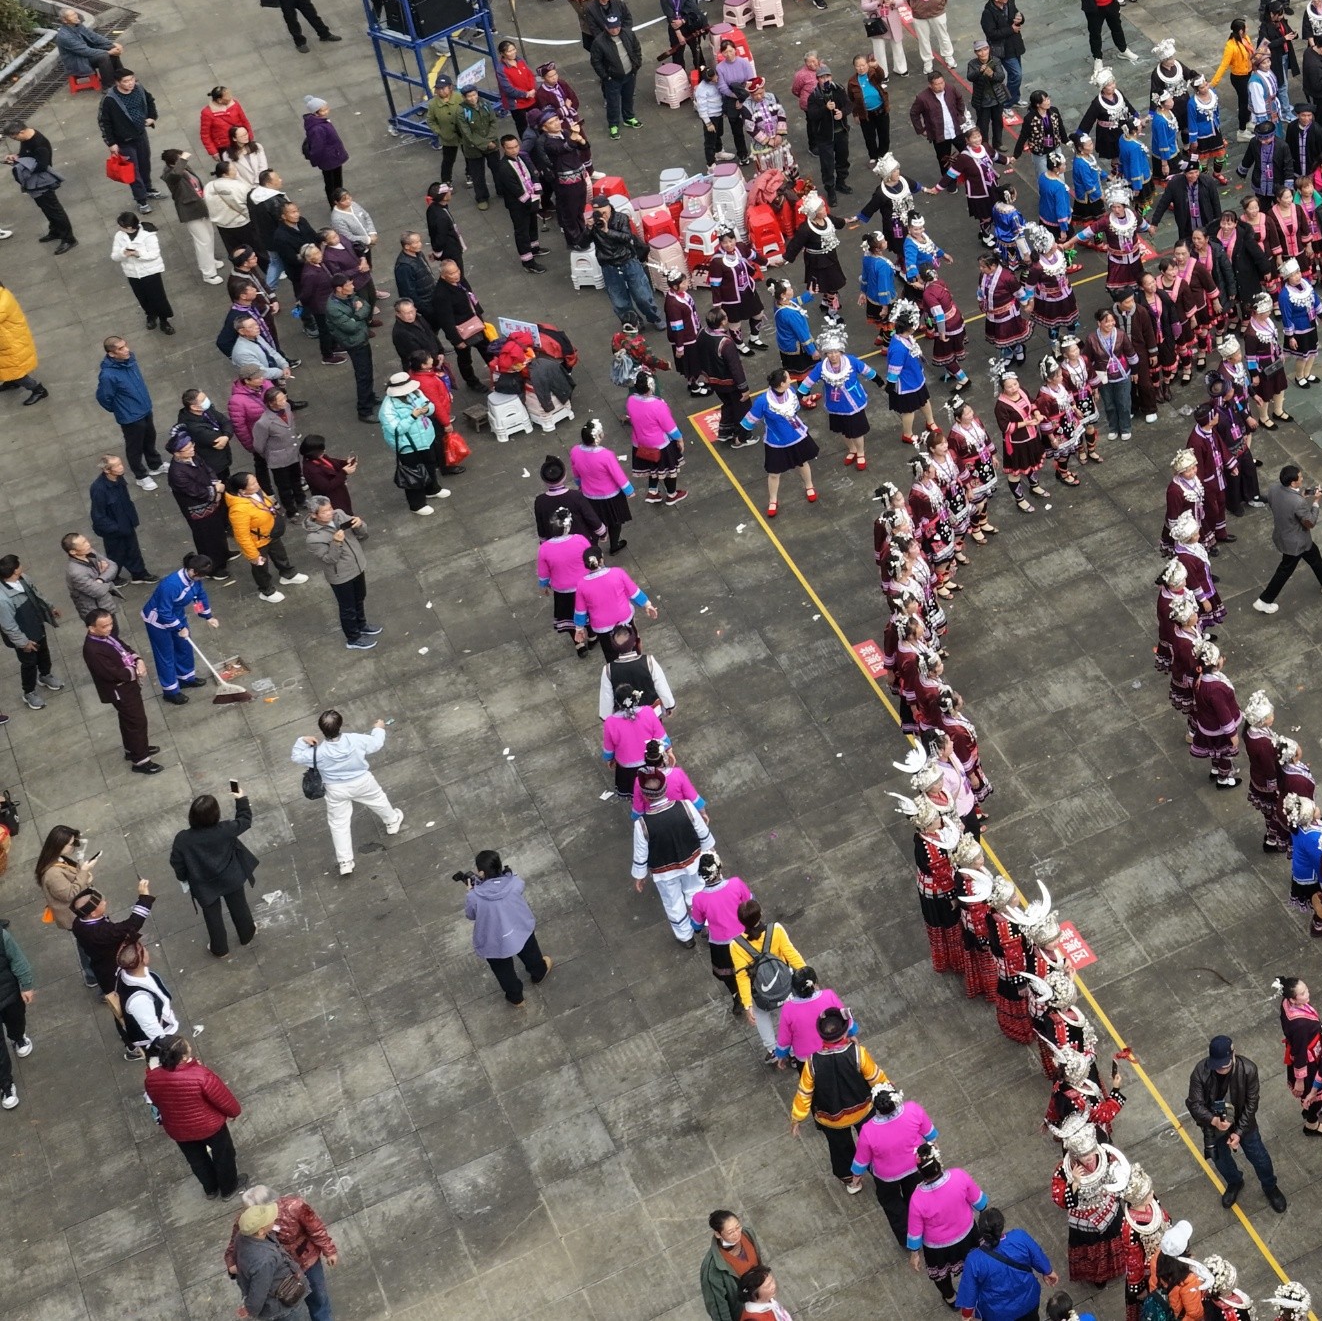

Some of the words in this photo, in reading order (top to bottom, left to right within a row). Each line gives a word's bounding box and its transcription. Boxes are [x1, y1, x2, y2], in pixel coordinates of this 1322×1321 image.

[859, 645, 884, 673] 表演区
[1060, 927, 1089, 964] 表演区
